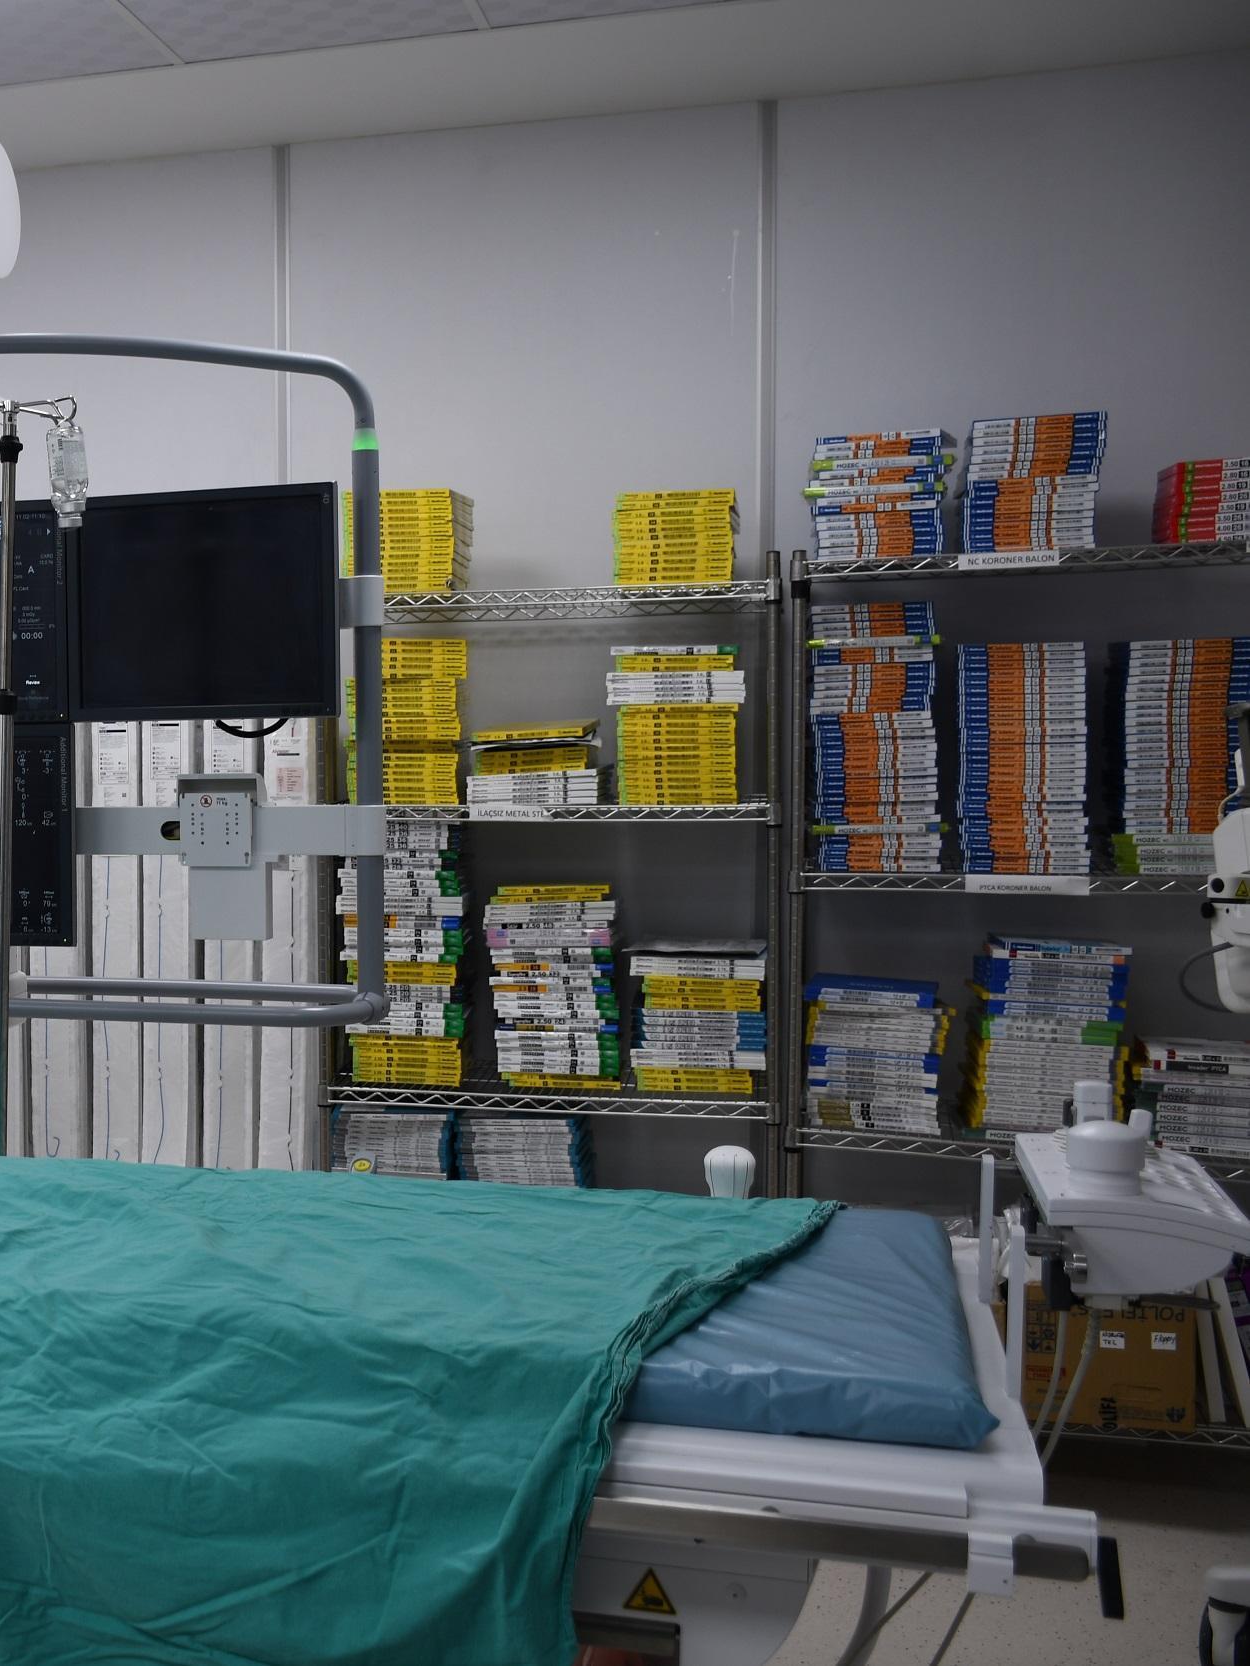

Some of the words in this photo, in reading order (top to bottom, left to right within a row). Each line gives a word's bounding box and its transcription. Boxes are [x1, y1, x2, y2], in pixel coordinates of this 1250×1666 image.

[982, 556, 1023, 565] KORONER
[1025, 555, 1055, 563] BALON
[28, 565, 35, 574] A
[21, 632, 43, 640] 00:00
[477, 808, 504, 818] İLAÇSIZ
[1168, 1087, 1196, 1095] MOZEC
[1159, 1124, 1188, 1132] MOZEC
[1162, 1135, 1191, 1143] MOZEC
